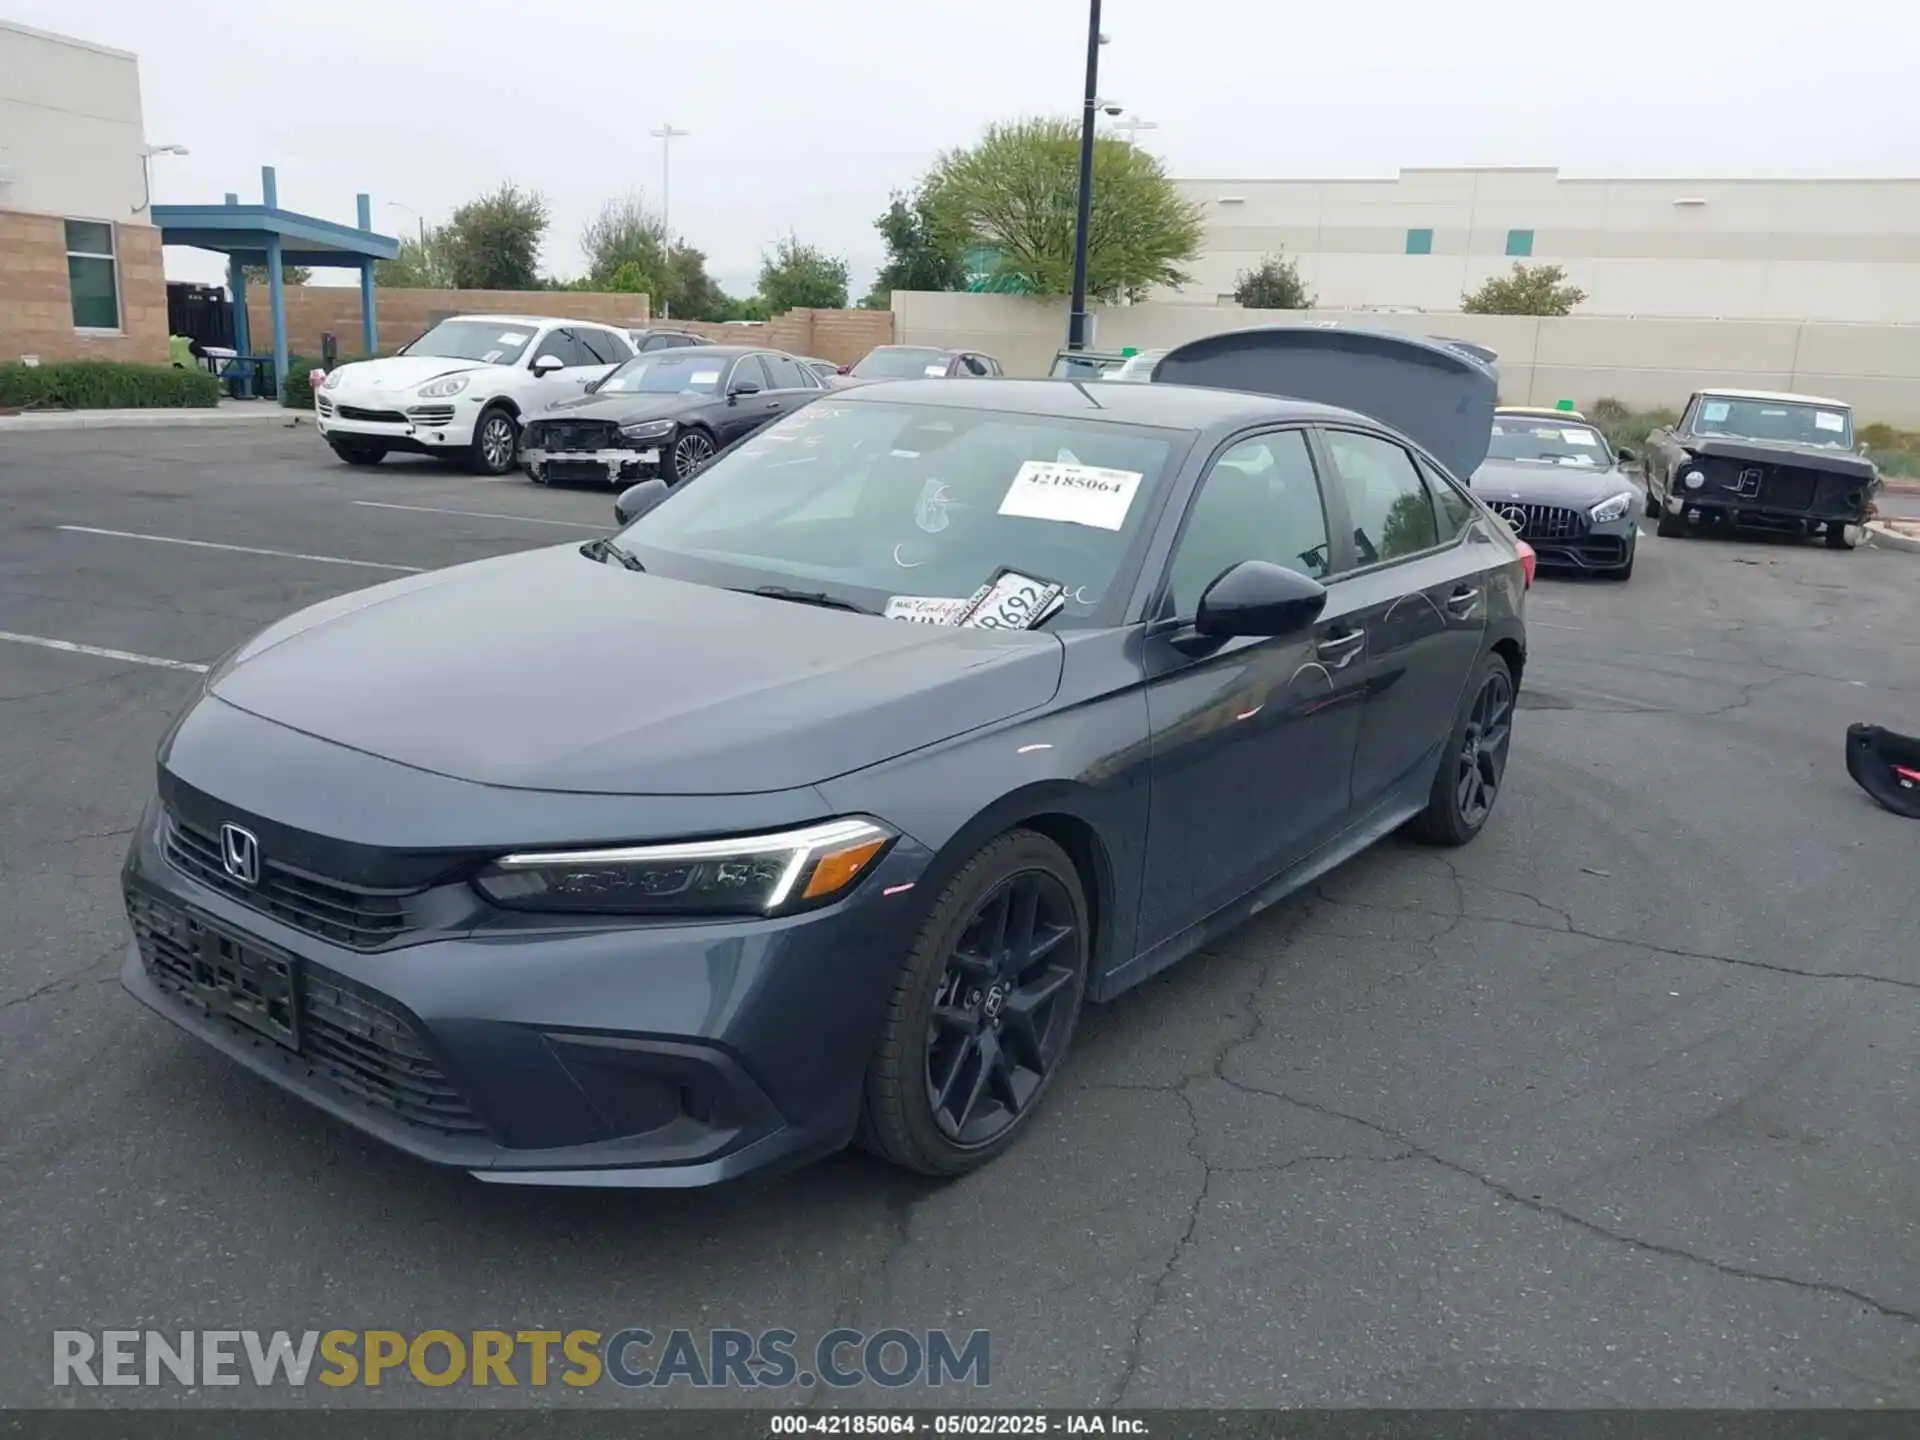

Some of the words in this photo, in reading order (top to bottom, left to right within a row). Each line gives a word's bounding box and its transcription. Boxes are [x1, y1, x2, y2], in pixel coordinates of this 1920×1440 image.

[1028, 473, 1123, 493] 42185064
[974, 586, 1037, 629] R692
[1024, 589, 1056, 621] Honda
